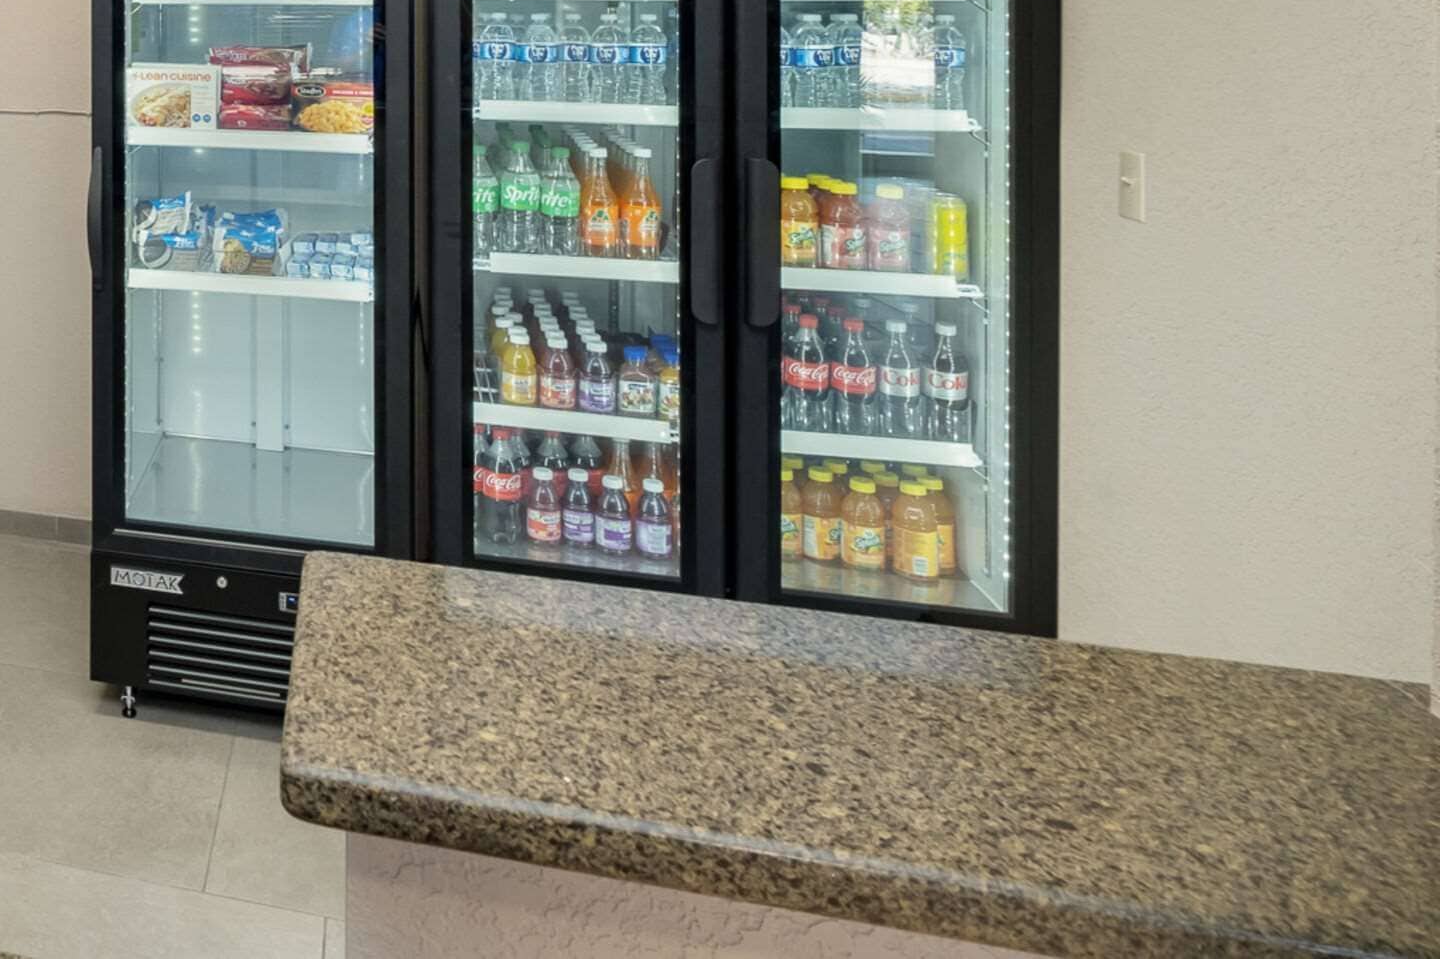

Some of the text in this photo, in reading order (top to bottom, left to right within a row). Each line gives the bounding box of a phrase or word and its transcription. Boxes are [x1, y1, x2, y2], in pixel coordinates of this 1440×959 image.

[884, 369, 920, 386] Cok
[928, 374, 968, 390] Cok
[114, 570, 179, 591] MOTAK
